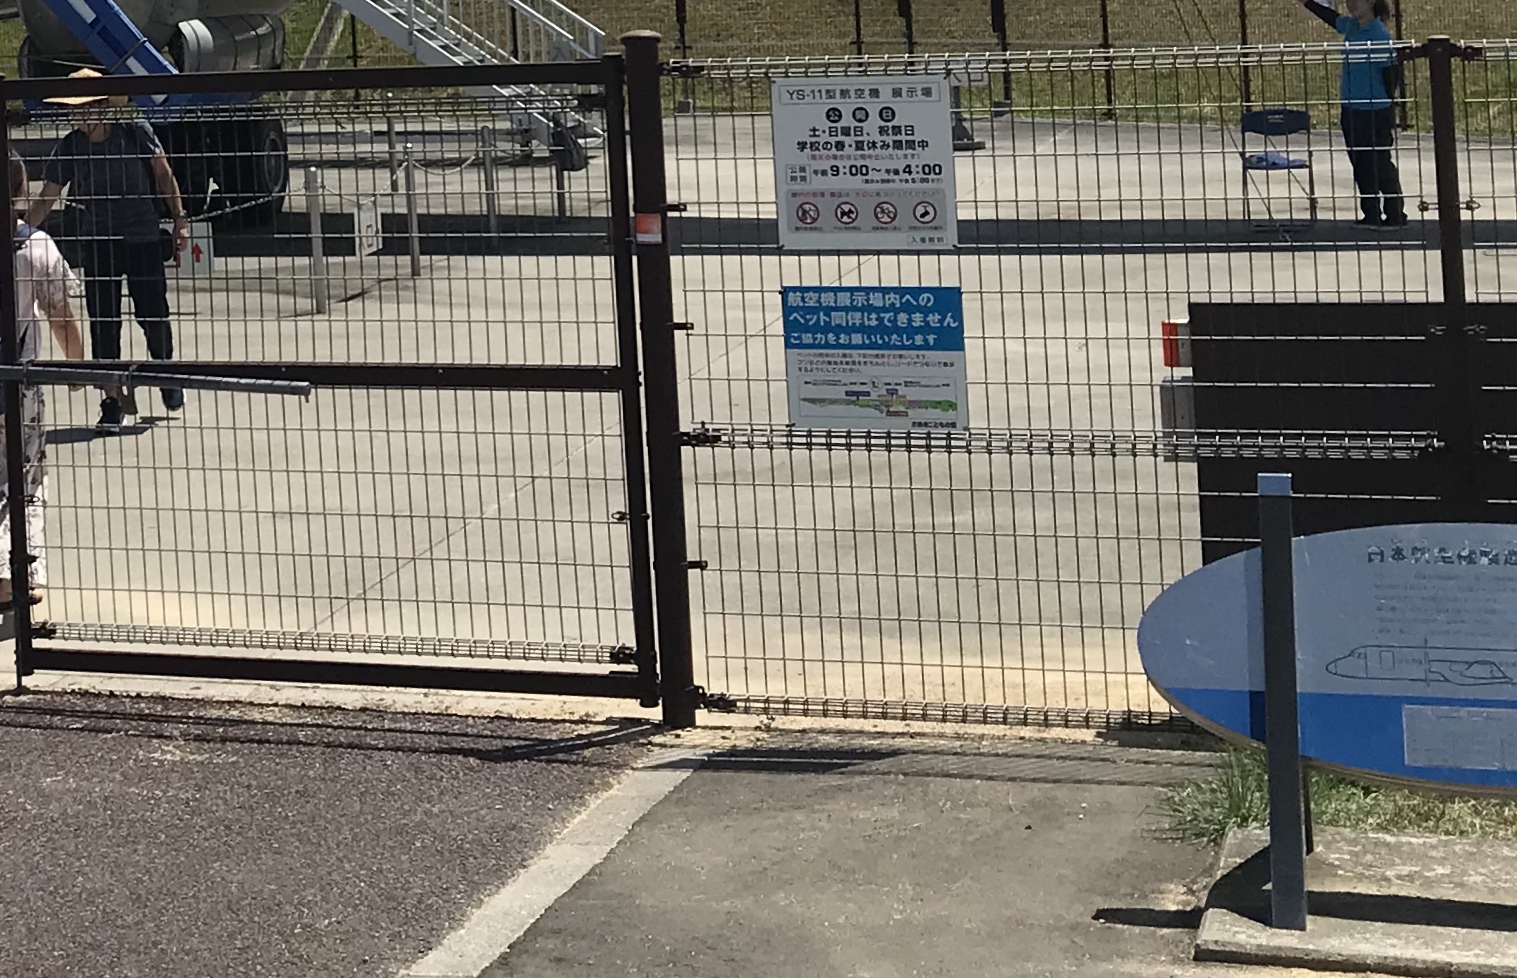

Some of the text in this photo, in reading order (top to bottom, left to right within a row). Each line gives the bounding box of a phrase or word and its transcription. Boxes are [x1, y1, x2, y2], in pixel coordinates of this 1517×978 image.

[786, 86, 933, 101] YS-11型航空機 展示場
[796, 139, 929, 153] 学校の春・夏休み期間中
[787, 291, 935, 307] 航空機展示場内への
[788, 310, 959, 328] ペット同伴はできません
[790, 332, 938, 346] ご協力をお願いいたします
